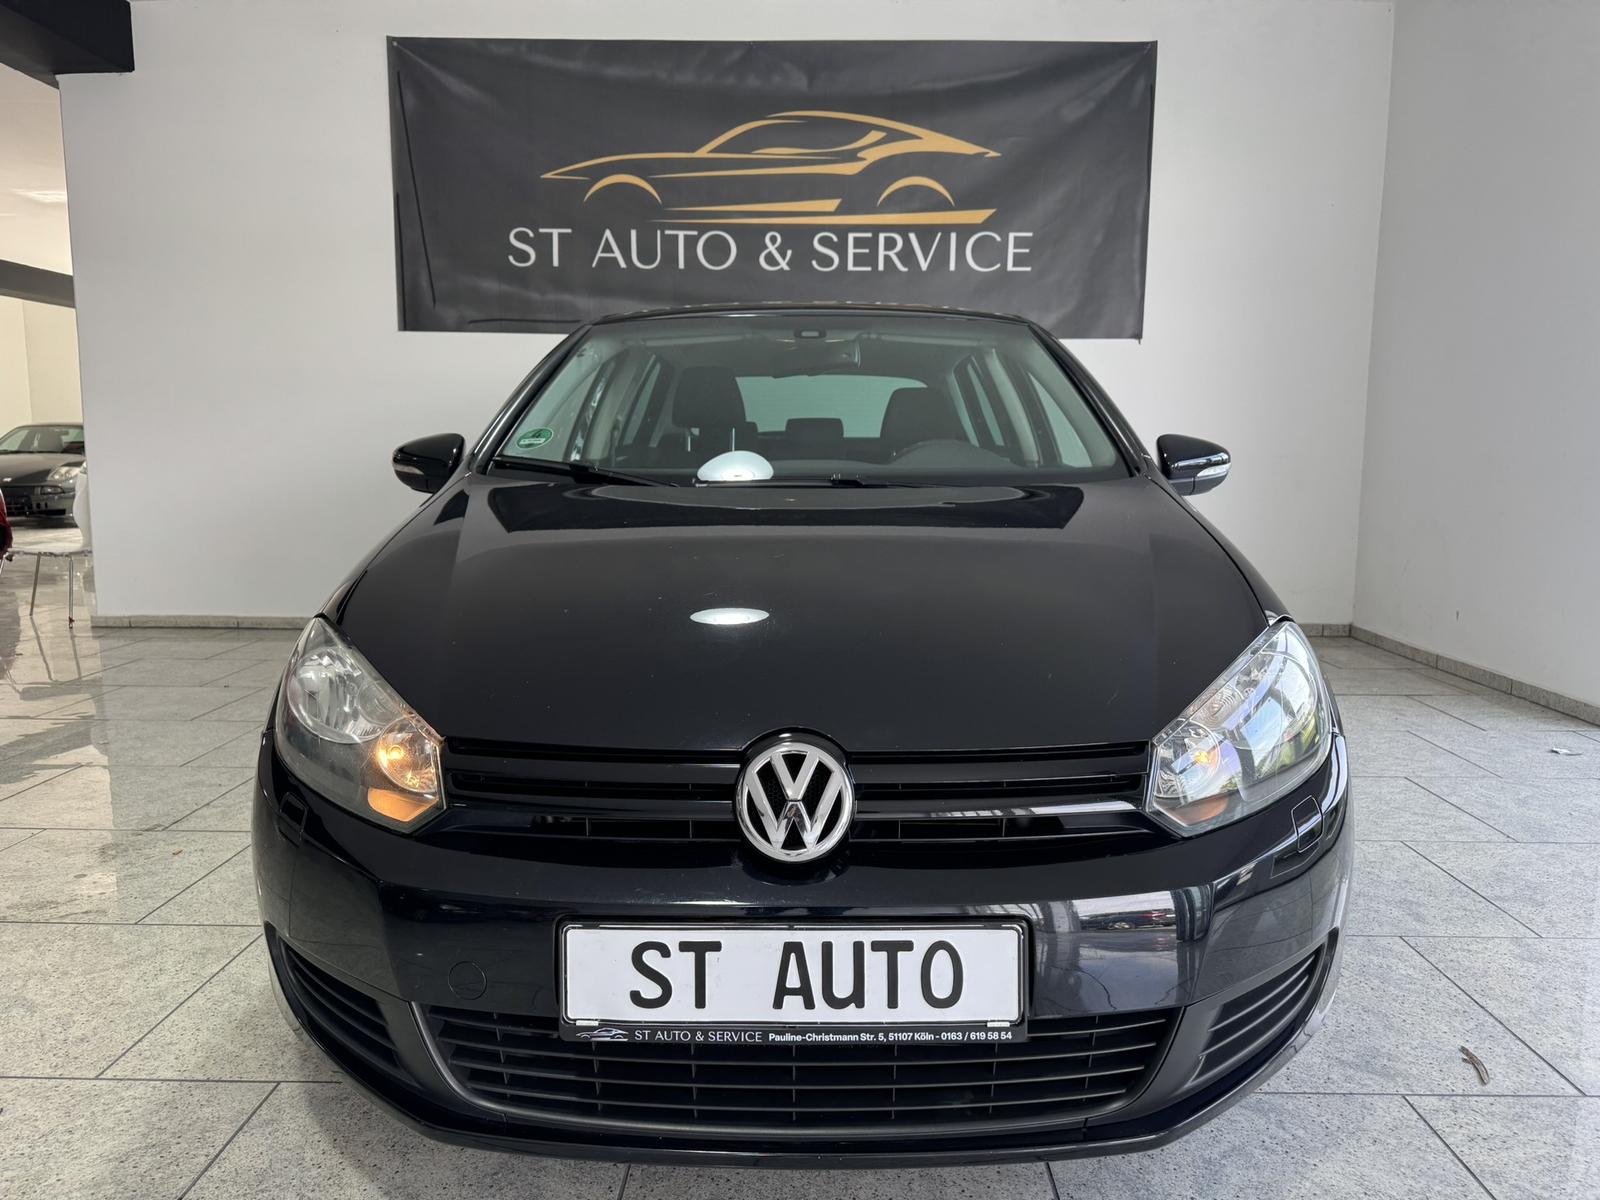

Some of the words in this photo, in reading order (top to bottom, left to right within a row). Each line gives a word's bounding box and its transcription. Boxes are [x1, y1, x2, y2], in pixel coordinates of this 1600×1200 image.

[508, 227, 572, 268] ST
[592, 229, 738, 271] AUTO
[757, 231, 792, 272] &
[811, 231, 1034, 274] SERVICE
[629, 940, 722, 1009] ST
[772, 940, 964, 1010] AUTO
[634, 1030, 652, 1041] ST
[654, 1030, 691, 1042] AUTO
[695, 1030, 705, 1042] &
[708, 1031, 763, 1043] SERVICE
[768, 1032, 859, 1043] Pauline-Christmann
[860, 1032, 877, 1042] Str.
[878, 1032, 887, 1043] 5,
[888, 1032, 913, 1041] 51107
[914, 1031, 935, 1041] Köln
[940, 1031, 963, 1041] 0163
[963, 1031, 969, 1041] /
[969, 1031, 986, 1041] 619
[987, 1031, 999, 1041] 58
[1000, 1031, 1013, 1040] 54
